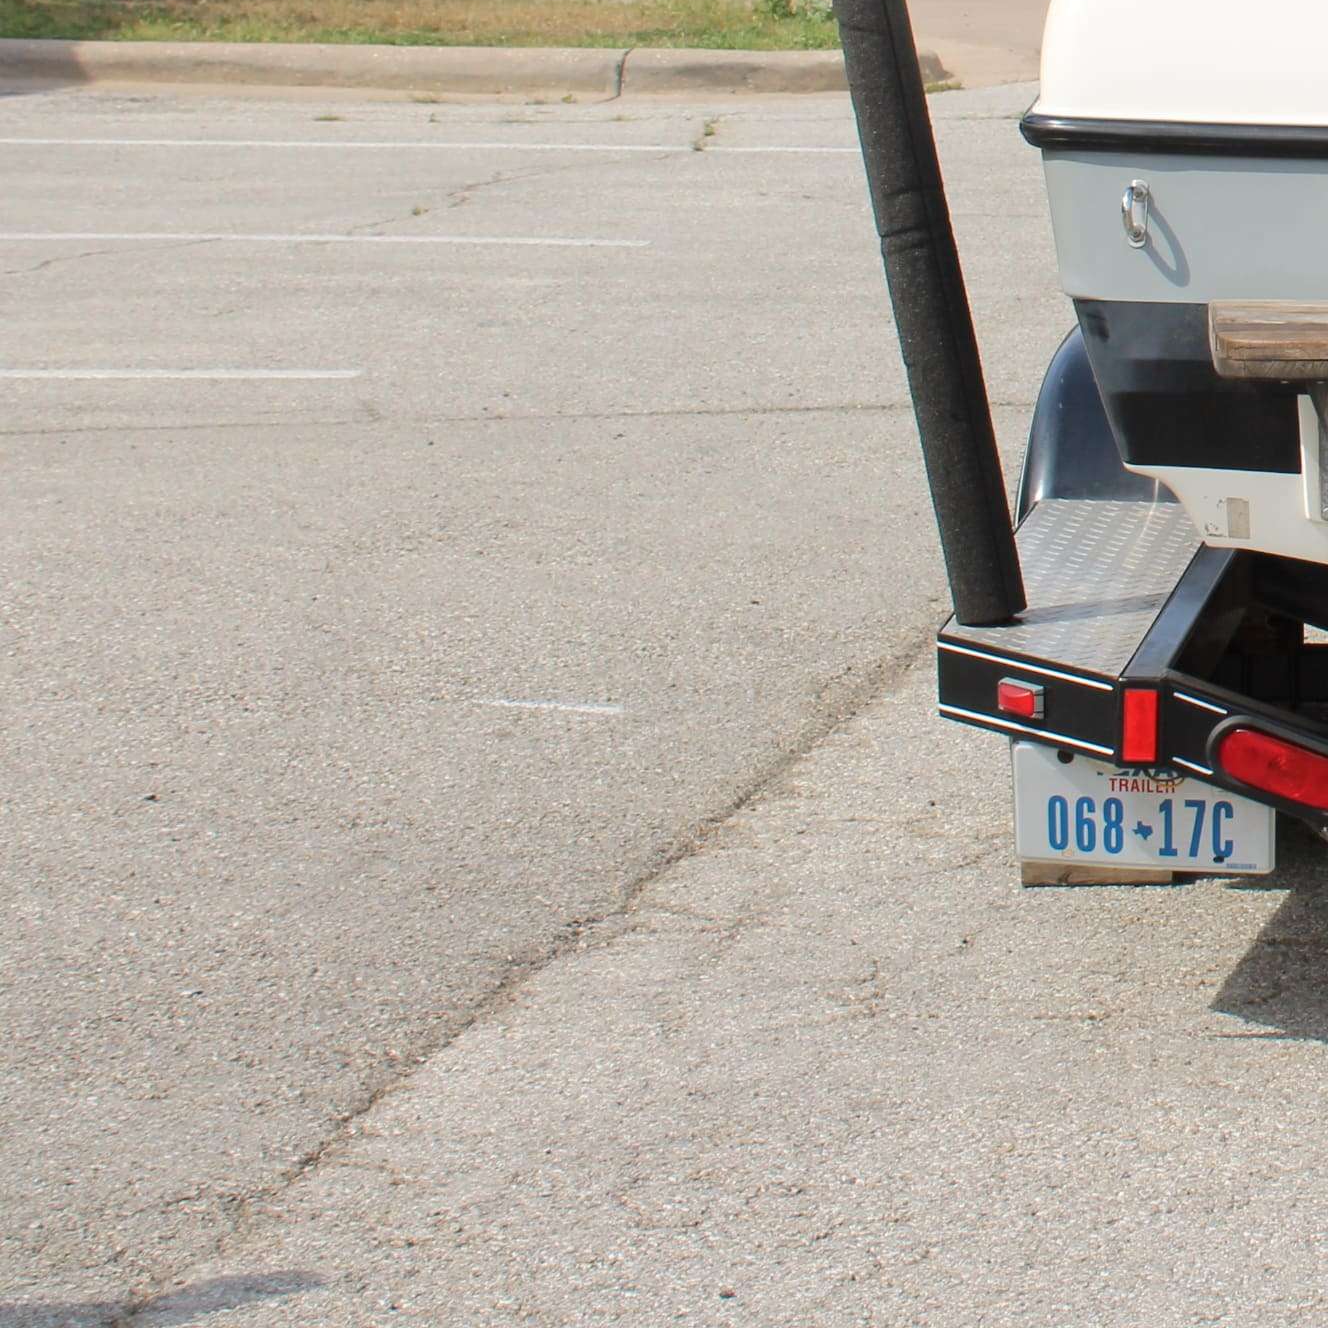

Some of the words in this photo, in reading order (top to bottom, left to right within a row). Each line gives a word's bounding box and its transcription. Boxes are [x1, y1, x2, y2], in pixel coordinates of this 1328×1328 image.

[1108, 777, 1176, 793] TRAILER
[1047, 795, 1124, 855] 068
[1158, 798, 1234, 859] 17C
